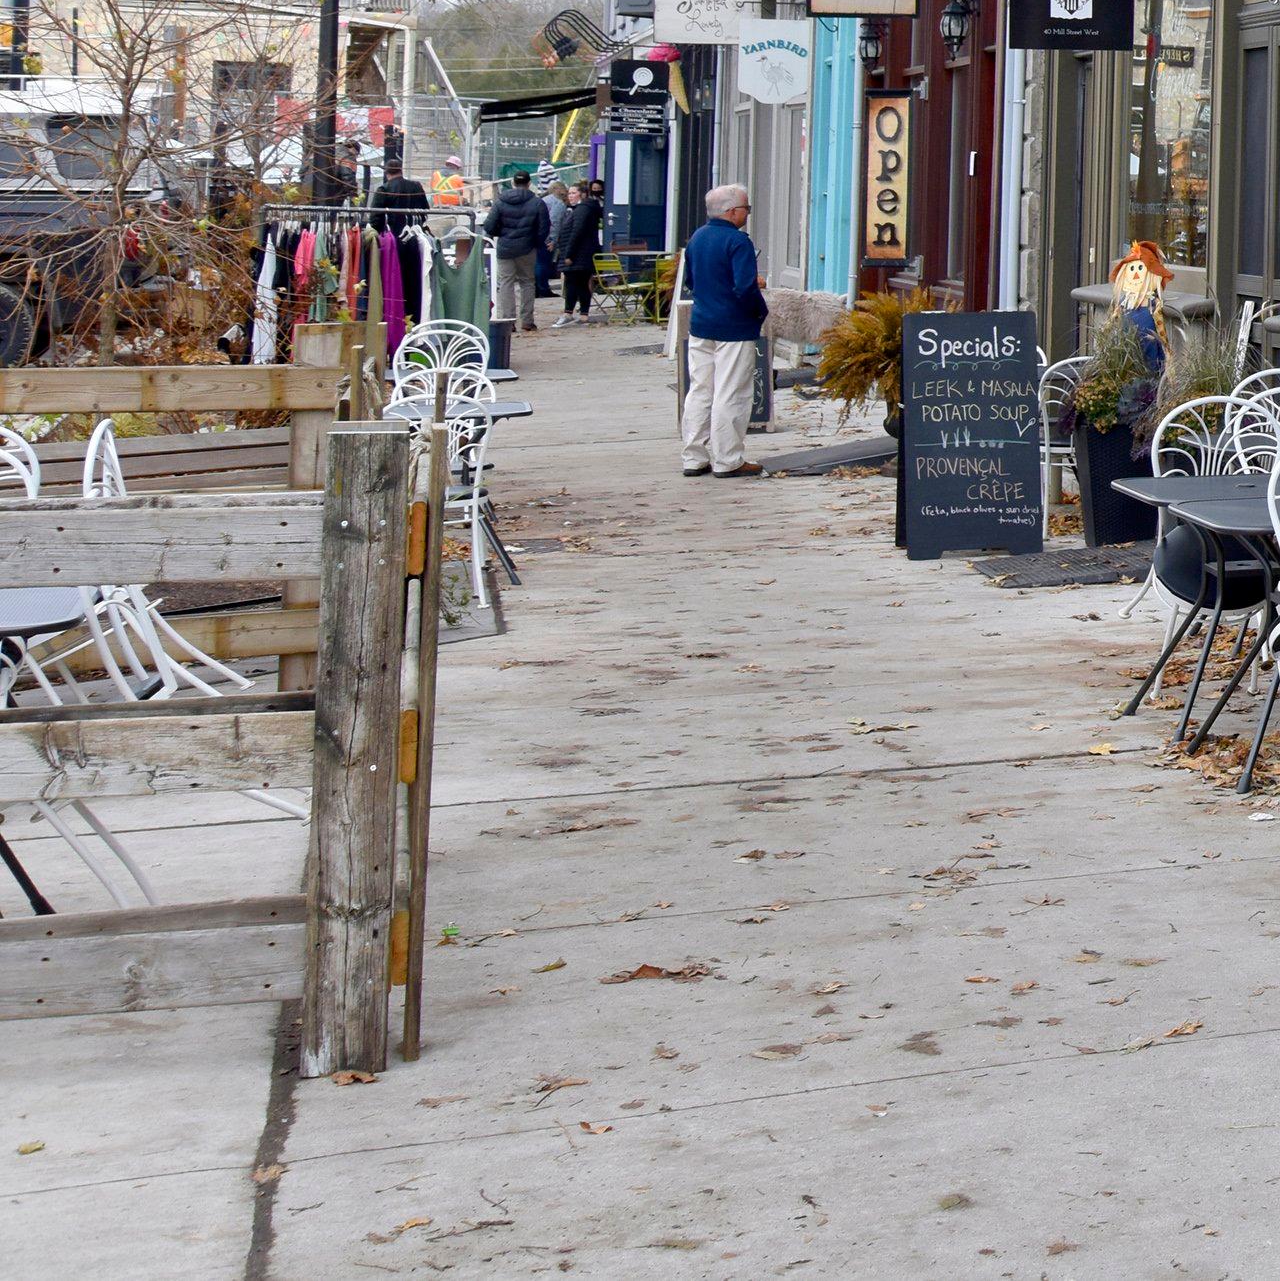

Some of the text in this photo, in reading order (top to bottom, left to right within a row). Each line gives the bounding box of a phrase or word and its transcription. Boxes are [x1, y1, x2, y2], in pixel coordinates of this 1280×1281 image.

[741, 39, 808, 58] YARNBIRD
[872, 106, 902, 247] Open
[918, 326, 1021, 368] Specials:
[912, 379, 964, 399] LEEK
[981, 380, 1037, 398] MASALA
[922, 403, 1030, 422] POTATO SOUP
[916, 456, 1011, 481] PROVENÇAL
[967, 479, 1025, 502] CRÊPE
[973, 505, 996, 513] olives
[1005, 506, 1020, 514] sun
